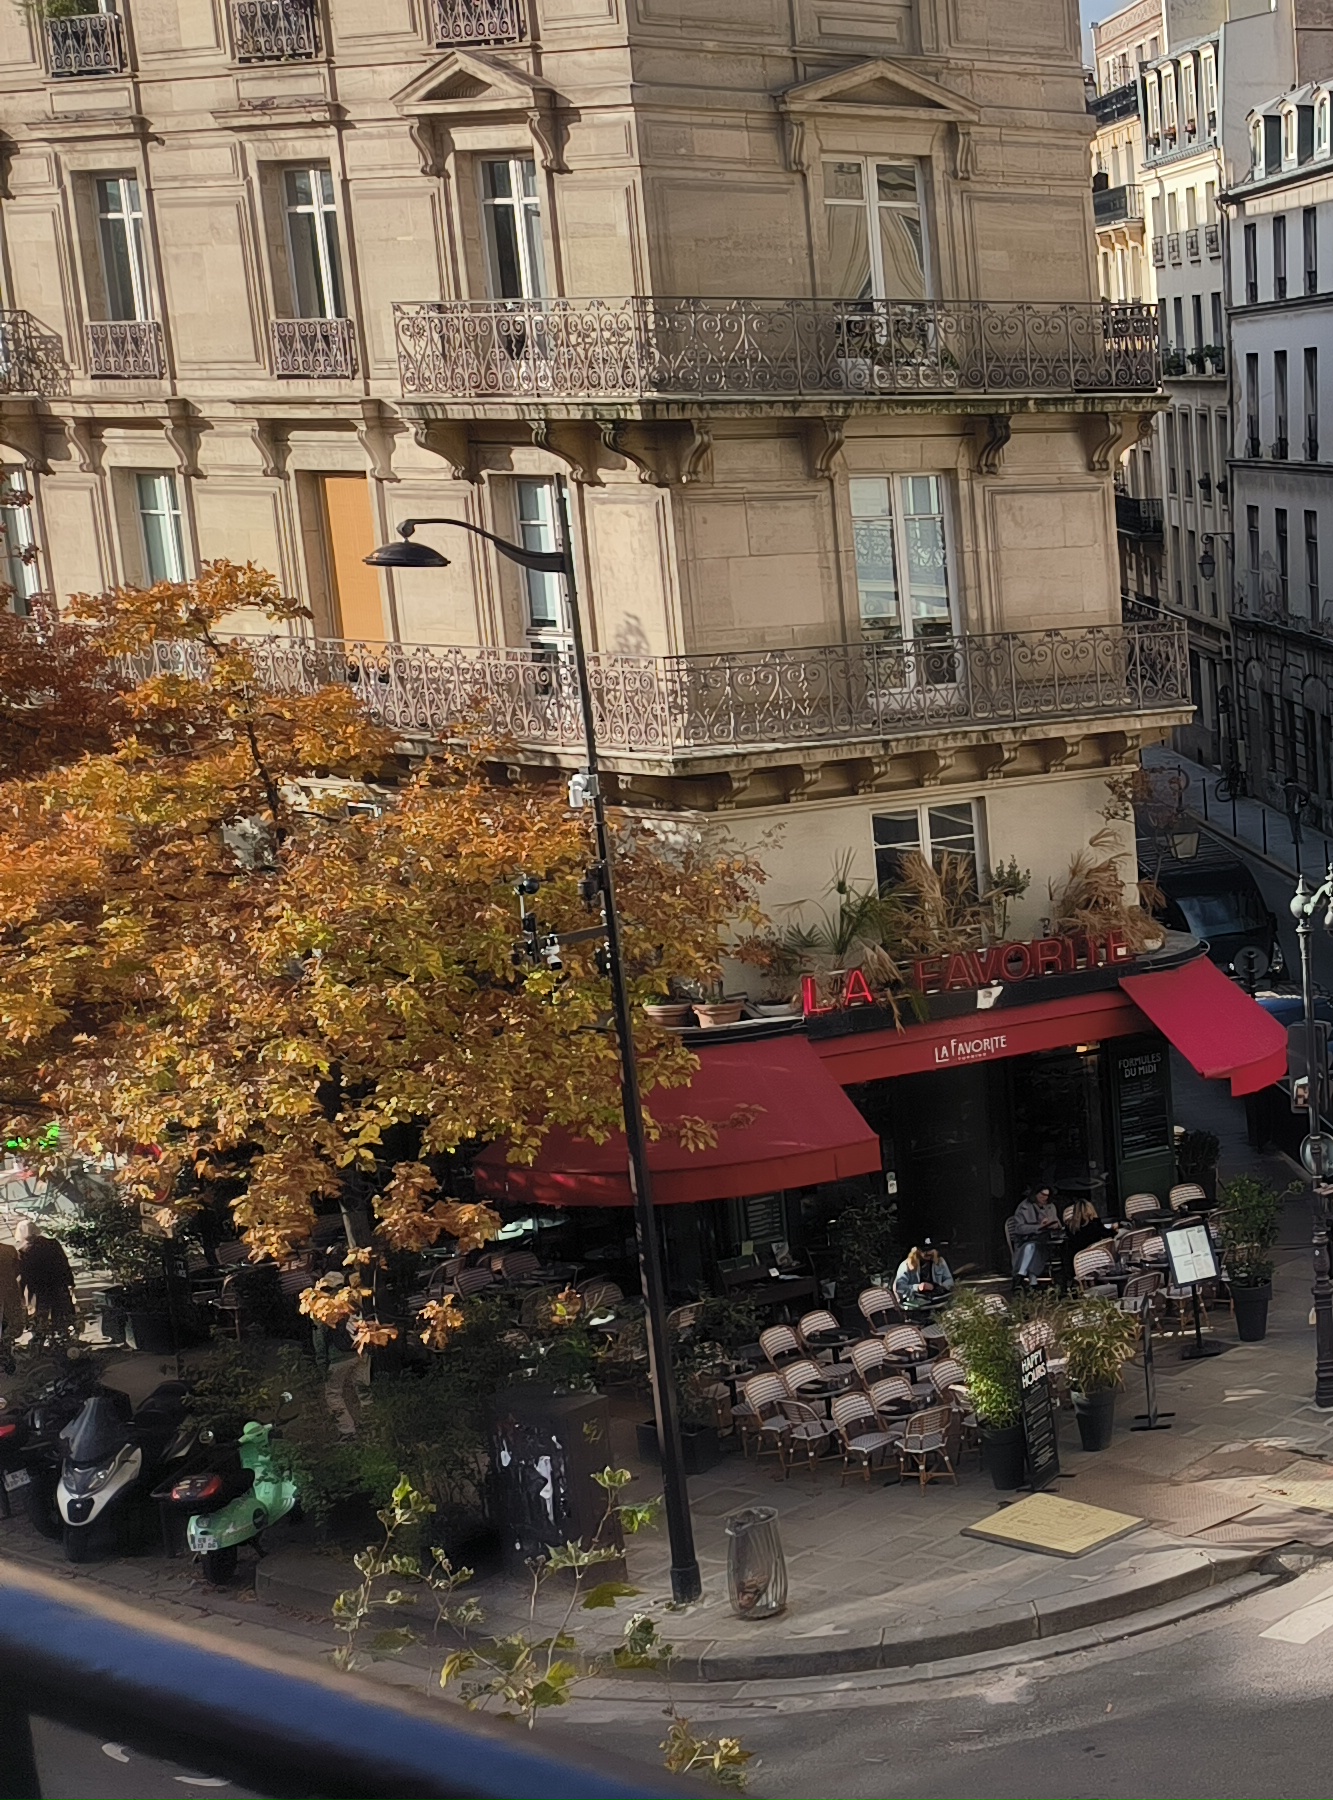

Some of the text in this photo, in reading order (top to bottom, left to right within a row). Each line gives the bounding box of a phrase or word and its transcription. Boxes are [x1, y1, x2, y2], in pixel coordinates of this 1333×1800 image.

[801, 928, 1136, 1016] LA FAVORITE
[934, 1046, 949, 1063] LA
[950, 1035, 1007, 1056] FAVORITE
[1118, 1053, 1161, 1069] FORMULES
[1124, 1063, 1157, 1078] DU MIDI
[1021, 1349, 1043, 1372] HAPPY
[1022, 1362, 1047, 1389] HOURS
